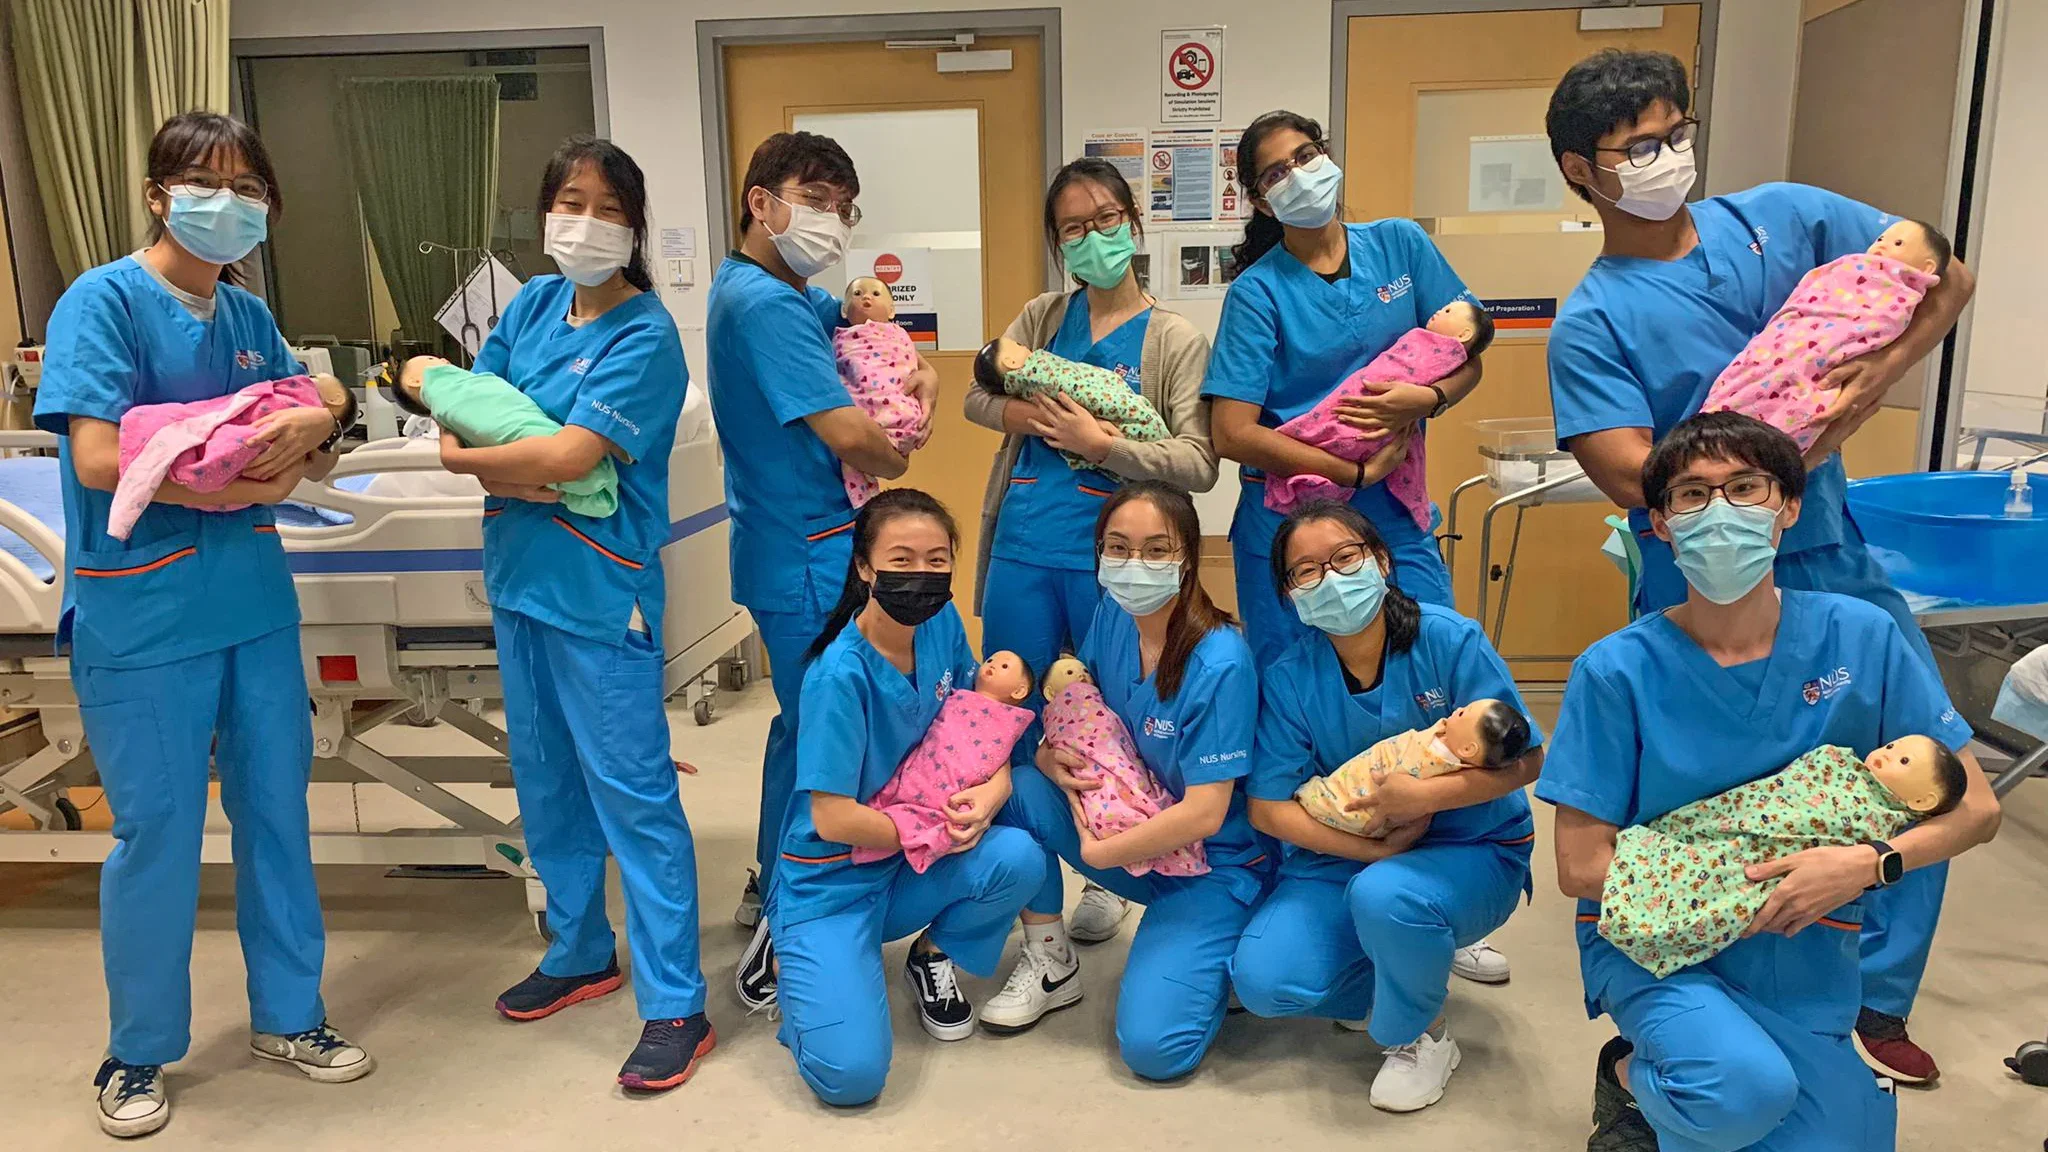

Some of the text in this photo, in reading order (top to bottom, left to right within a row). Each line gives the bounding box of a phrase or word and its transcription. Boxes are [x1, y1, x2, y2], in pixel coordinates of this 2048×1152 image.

[1387, 274, 1411, 292] NUS
[1495, 305, 1535, 313] Preparation
[1128, 366, 1141, 376] NU
[591, 399, 640, 436] NUS Nursing
[1819, 666, 1850, 690] NUS
[1425, 686, 1444, 701] NU
[1155, 718, 1174, 732] NUS
[1199, 749, 1247, 764] NUS Nursing
